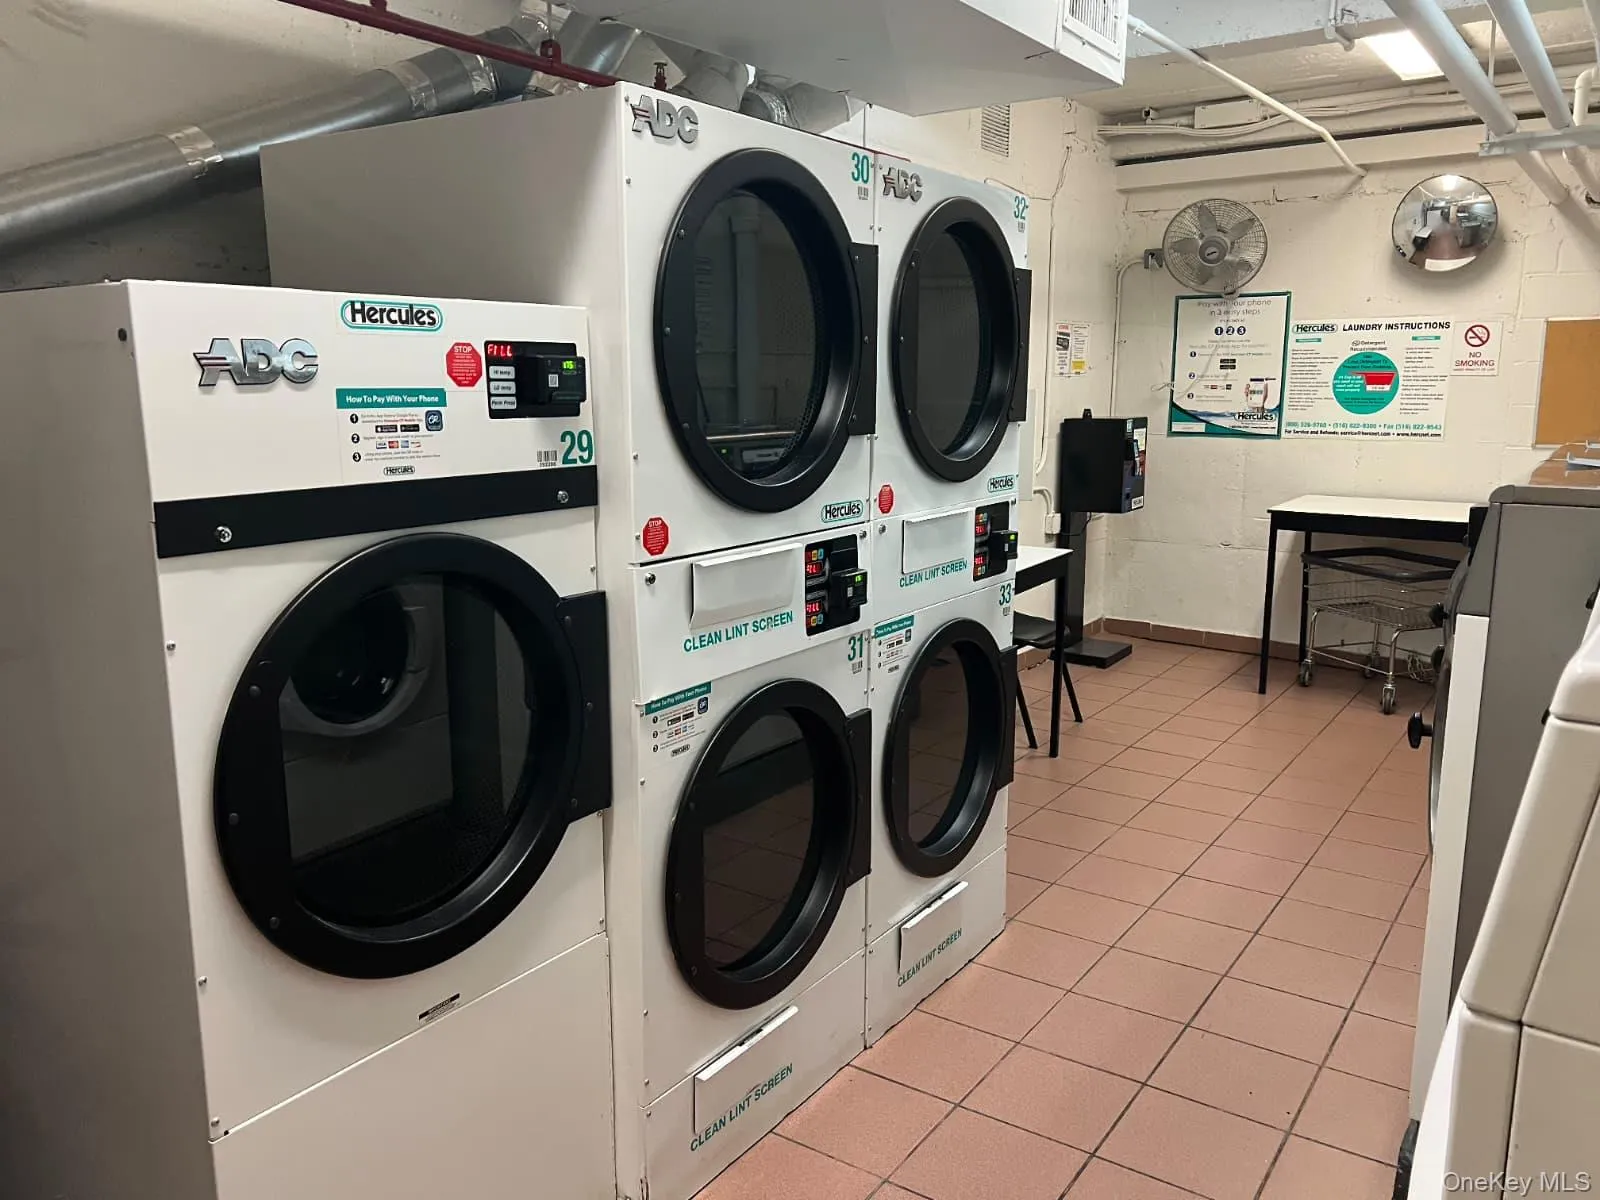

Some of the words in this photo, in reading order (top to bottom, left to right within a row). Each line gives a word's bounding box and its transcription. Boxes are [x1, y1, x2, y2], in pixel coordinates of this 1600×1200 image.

[630, 95, 699, 144] ADC
[851, 152, 869, 184] 30
[882, 167, 923, 202] ADC
[1014, 195, 1026, 220] 32
[350, 299, 437, 327] Hercules
[1296, 323, 1336, 333] Hercules
[1342, 323, 1382, 332] LAUNDRY
[1385, 321, 1451, 331] INSTRUCTIONS
[193, 338, 319, 387] ADC
[453, 345, 473, 354] STOP
[1455, 359, 1495, 367] SMOKING
[346, 395, 362, 403] How
[363, 395, 372, 403] To
[373, 395, 385, 405] Pay
[386, 395, 402, 403] With
[402, 394, 418, 403] Your
[419, 394, 439, 403] Phone
[1237, 411, 1274, 421] Hercules
[560, 429, 594, 465] 29
[386, 465, 414, 475] Hercules
[990, 475, 1014, 489] Hercules
[825, 501, 861, 519] Hercules
[899, 571, 923, 588] CLEAN
[924, 567, 941, 580] LINT
[941, 559, 968, 576] SCREEN
[999, 583, 1011, 605] 33
[683, 629, 722, 652] CLEAN
[725, 622, 749, 641] LINT
[752, 610, 794, 633] SCREEN
[848, 633, 864, 662] 31
[897, 961, 921, 988] CLEAN
[921, 947, 937, 968] LINT
[937, 927, 962, 955] SCREEN
[690, 1115, 726, 1152] CLEAN
[729, 1094, 752, 1122] LINT
[754, 1062, 793, 1102] SCREEN
